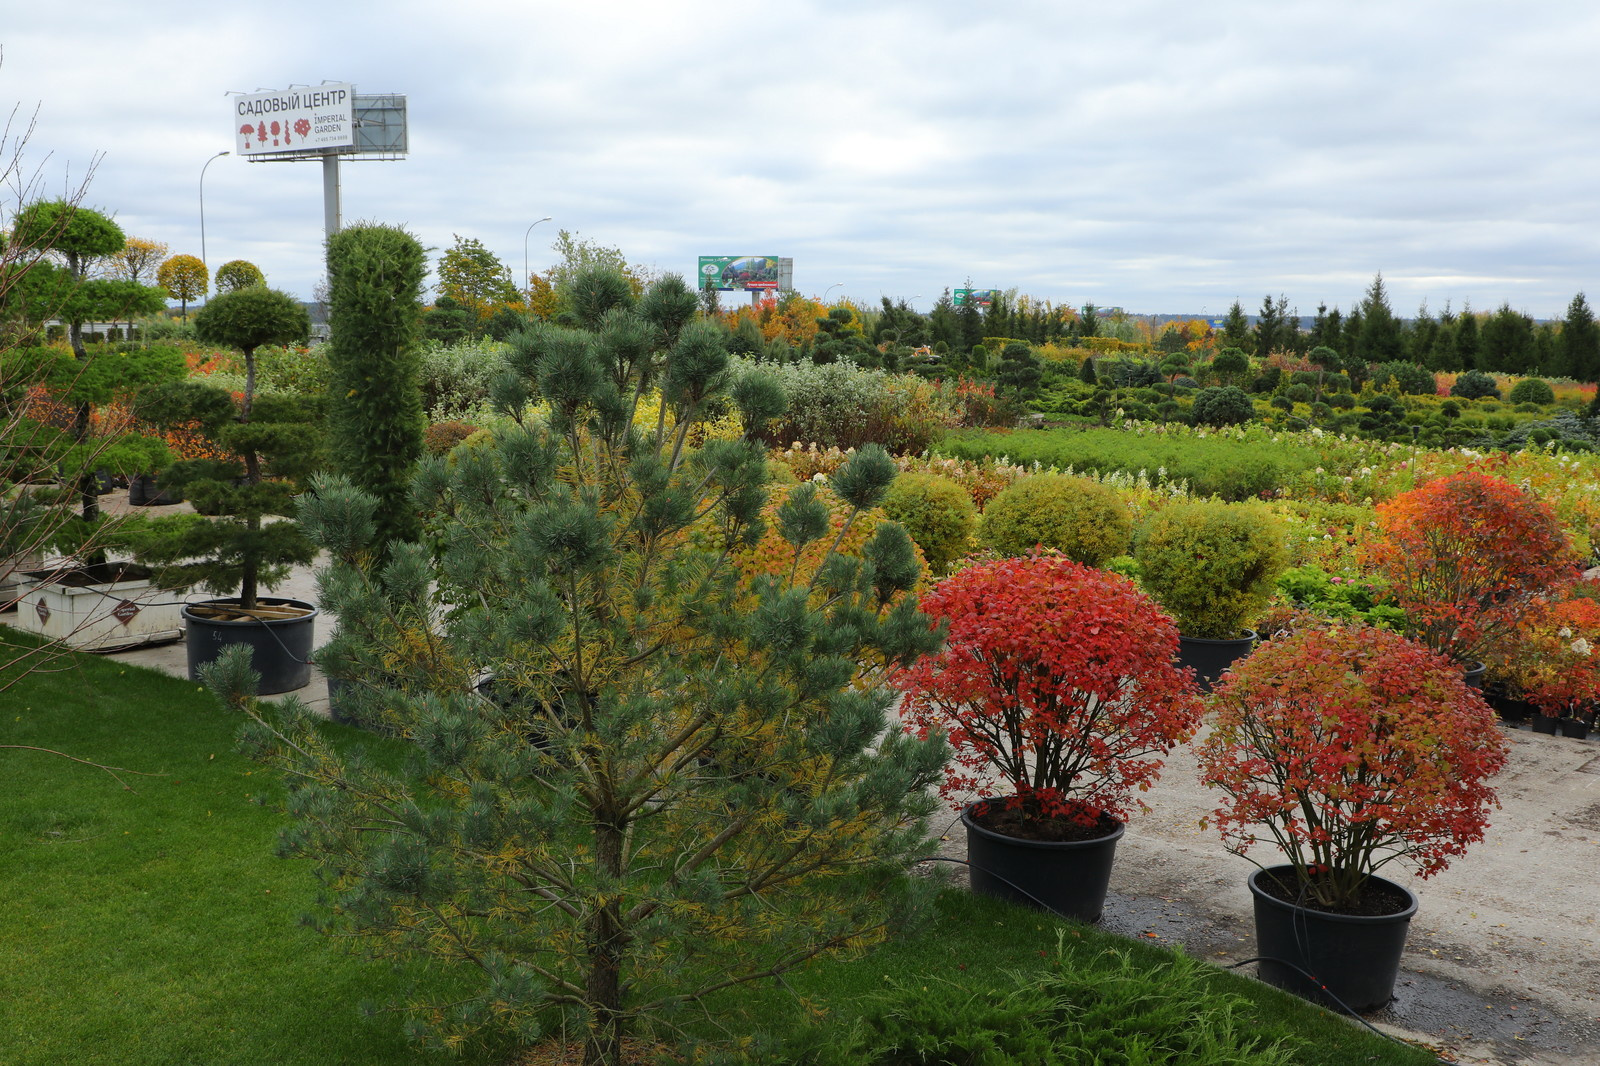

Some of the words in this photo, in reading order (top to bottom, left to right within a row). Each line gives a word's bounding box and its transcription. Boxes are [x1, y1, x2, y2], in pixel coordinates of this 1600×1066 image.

[238, 92, 300, 116] САДОВЫЙ
[303, 89, 346, 110] ЦЕНТР
[314, 124, 341, 134] GARDEN
[212, 630, 223, 642] 54
